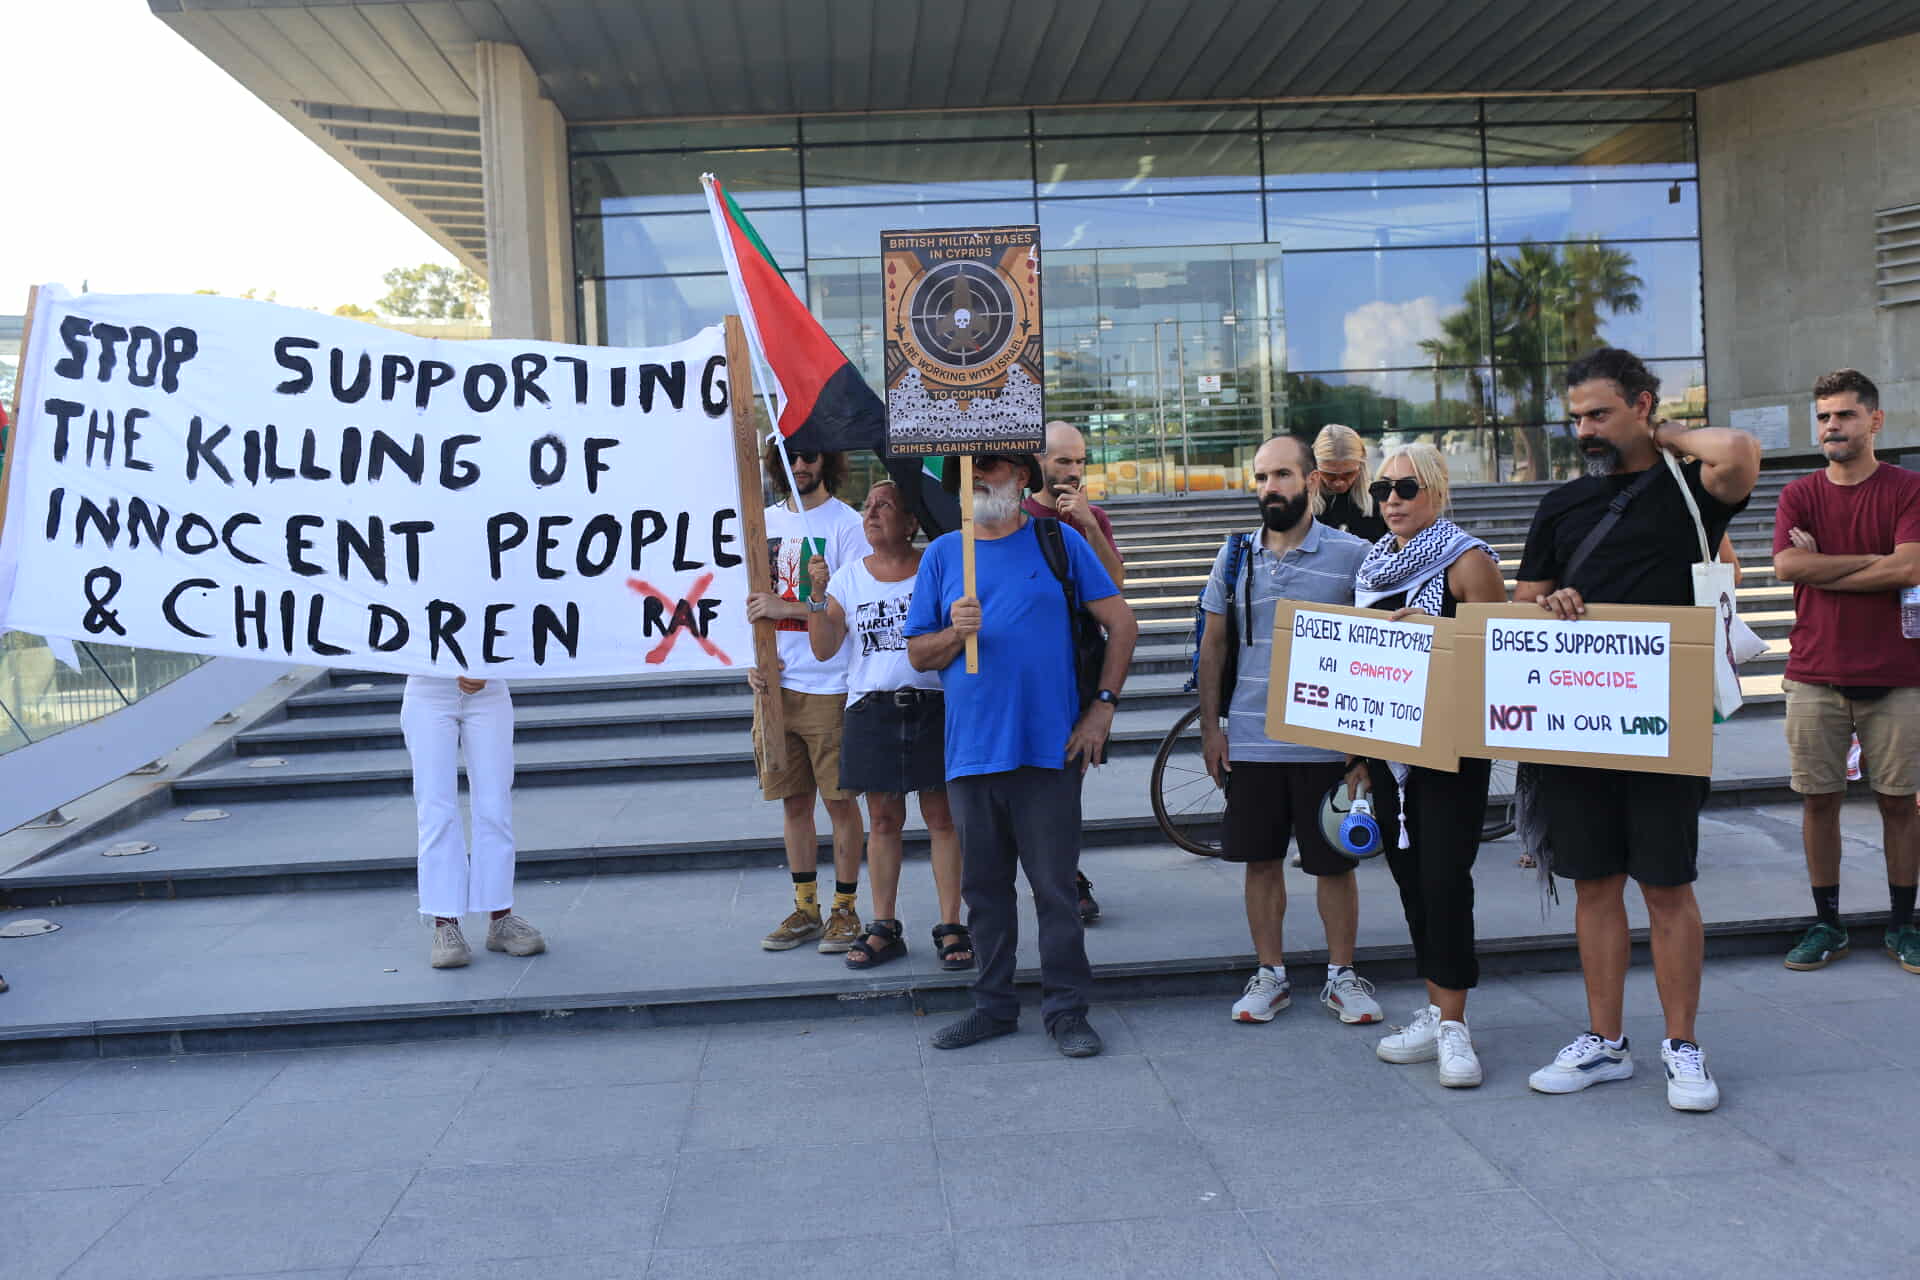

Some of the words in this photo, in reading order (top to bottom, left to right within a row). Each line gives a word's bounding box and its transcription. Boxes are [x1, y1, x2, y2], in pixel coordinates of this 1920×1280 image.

[889, 237, 935, 249] BRITISH
[939, 235, 991, 247] MILITARY
[994, 233, 1032, 244] BASES
[929, 249, 943, 259] IN
[945, 247, 993, 258] CYPRUS
[54, 315, 199, 394] STOP
[273, 336, 728, 418] SUPPORTING
[902, 341, 919, 360] ARE
[918, 358, 966, 382] WORKING
[968, 366, 995, 382] WITH
[996, 338, 1024, 370] ISRAEL
[932, 390, 948, 400] TO
[950, 388, 998, 400] COMMIT
[44, 398, 155, 472] THE
[185, 415, 482, 491] KILLING
[529, 432, 620, 494] OF
[891, 443, 934, 454] CRIMES
[935, 442, 982, 453] AGAINST
[984, 440, 1041, 452] HUMANITY
[46, 487, 436, 585] INNOCENT
[486, 508, 743, 581] PEOPLE
[83, 565, 127, 636] &
[162, 577, 580, 671] CHILDREN
[642, 595, 722, 639] RAF
[857, 616, 894, 632] MARCH
[1295, 614, 1342, 641] ΒΑΣΕΙΣ
[1348, 623, 1433, 653] ΚΑΤΑΣΤΡΟΦΗΣ
[1492, 628, 1548, 653] BASES
[1554, 631, 1665, 656] SUPPORTING
[1319, 656, 1337, 673] ΚΑΙ
[1350, 661, 1413, 683] ΘΑΝΑΤΟΥ
[1527, 669, 1541, 685] A
[1549, 669, 1638, 689] GENOCIDE
[1334, 693, 1358, 712] ΑΠΟ
[1362, 697, 1384, 717] ΤΟΝ
[1390, 702, 1422, 721] ΤΟΠΟ
[1489, 703, 1537, 731] NOT
[1547, 713, 1565, 731] IN
[1574, 714, 1612, 731] OUR
[1620, 716, 1667, 735] LAND
